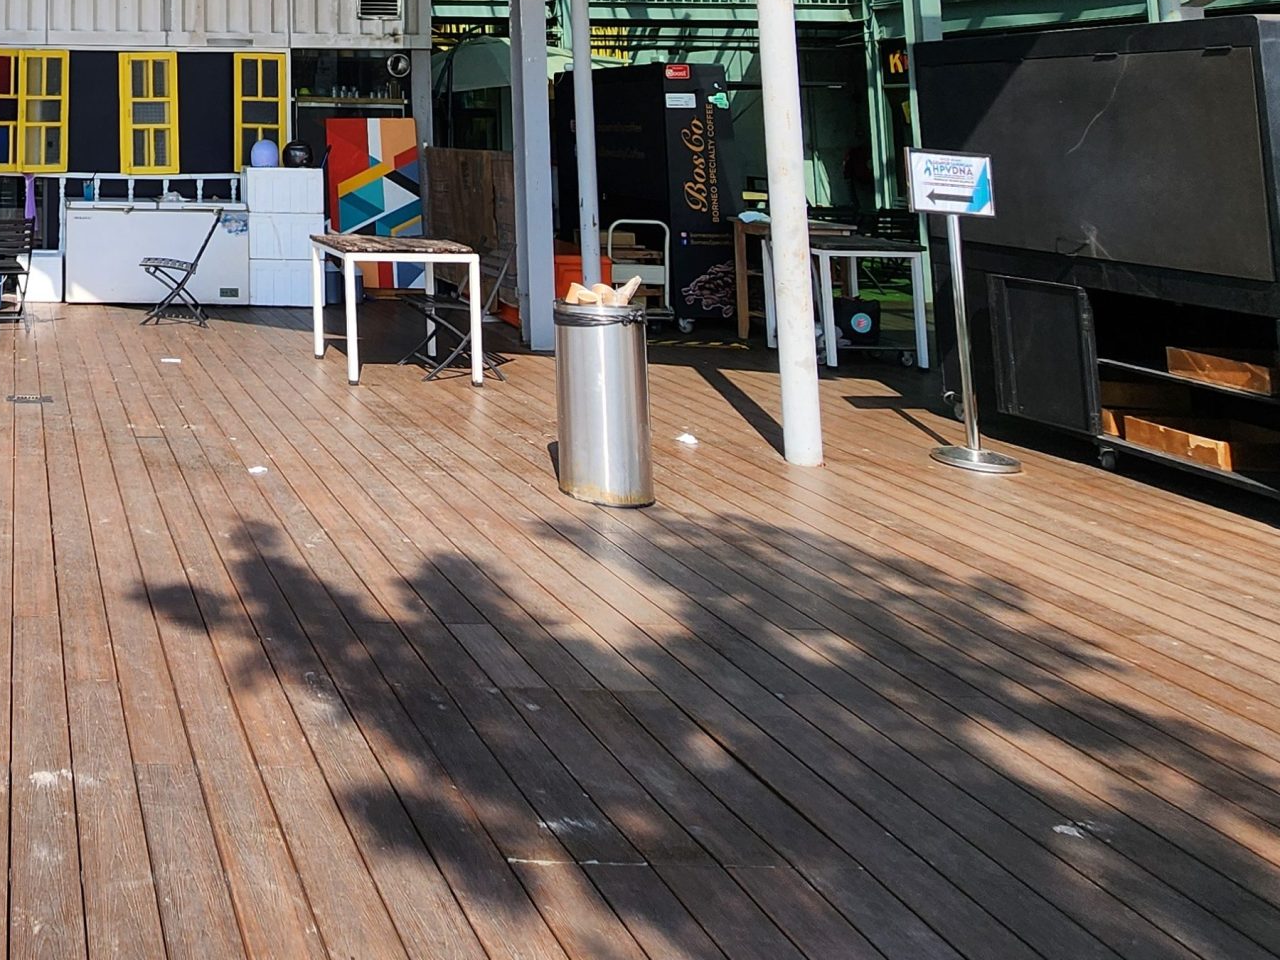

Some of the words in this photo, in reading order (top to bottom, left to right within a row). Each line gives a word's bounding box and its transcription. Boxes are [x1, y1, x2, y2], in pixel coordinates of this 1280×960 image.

[705, 103, 715, 137] COFFEE
[681, 114, 708, 212] BosCo
[708, 139, 717, 185] SPECIALTY
[710, 186, 720, 223] BORNEO
